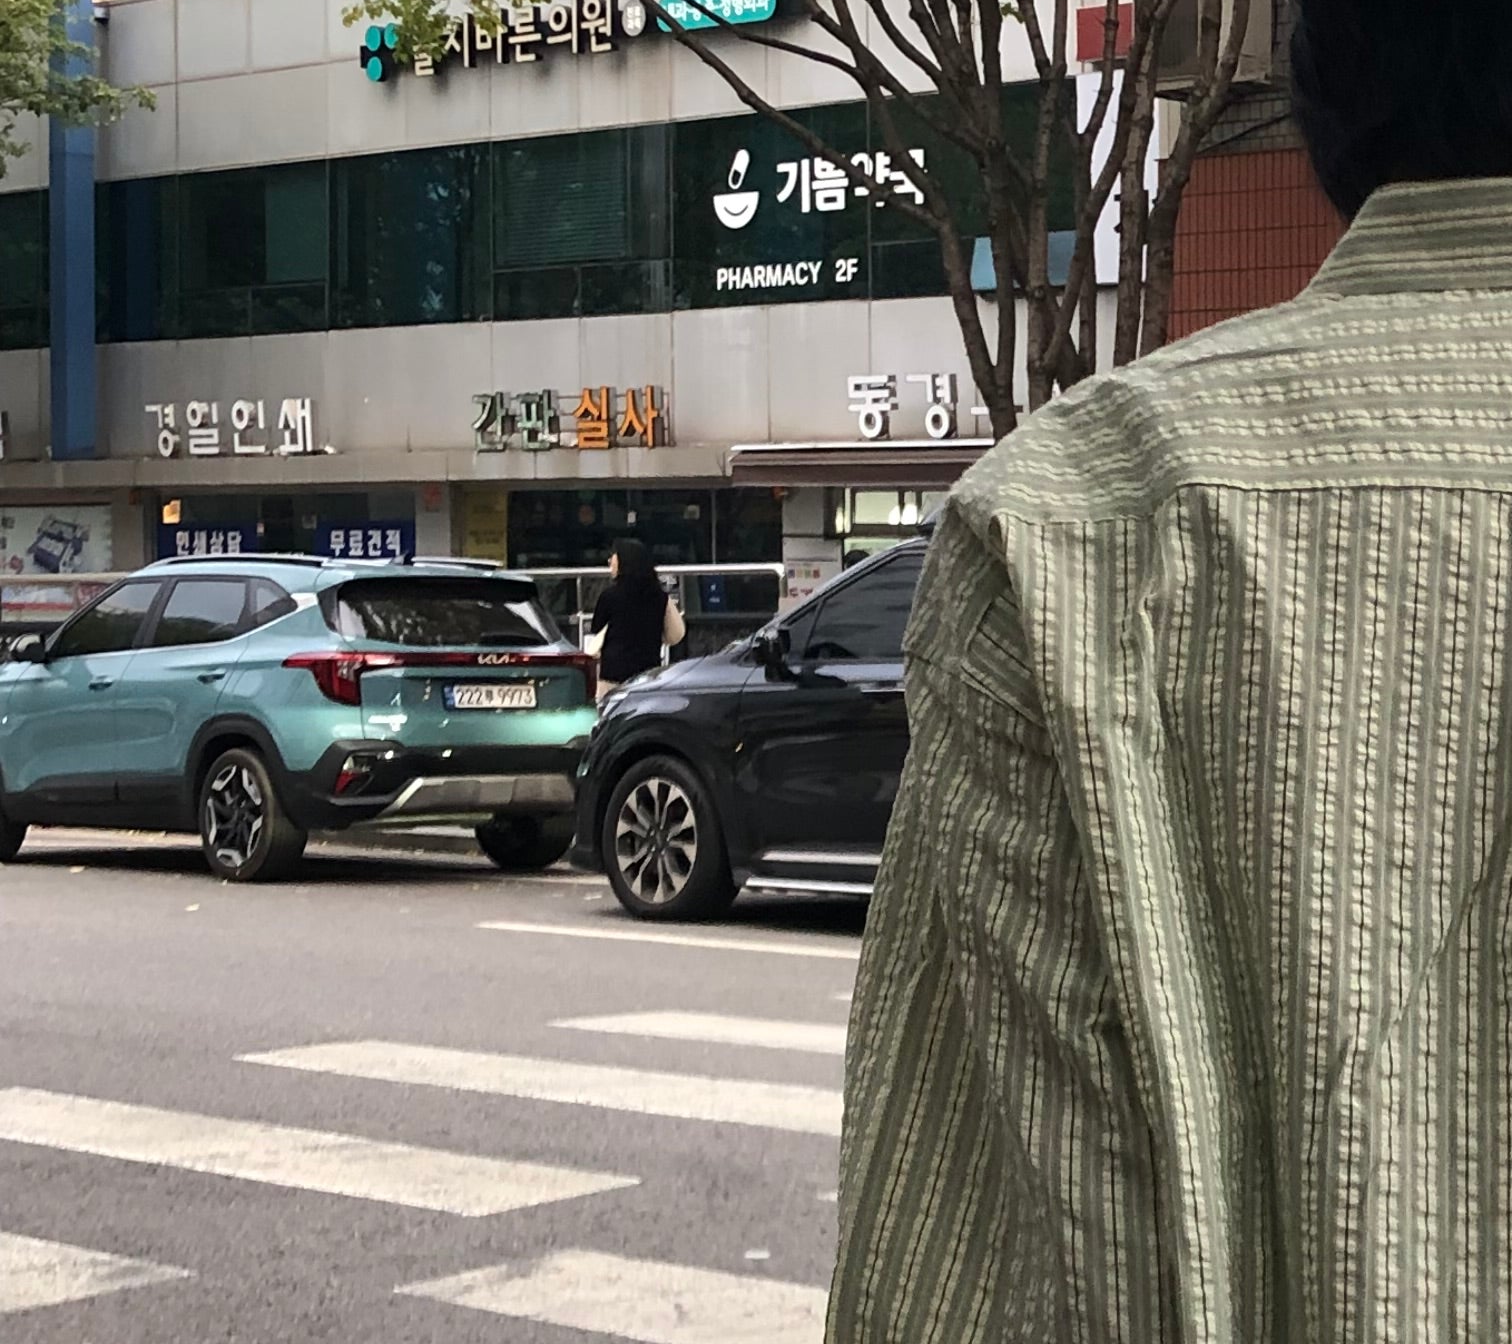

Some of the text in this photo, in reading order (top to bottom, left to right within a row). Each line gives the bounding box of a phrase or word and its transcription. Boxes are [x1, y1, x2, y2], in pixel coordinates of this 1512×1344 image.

[716, 258, 859, 291] PHARMACY 2F
[145, 398, 314, 457] 경일인쇄
